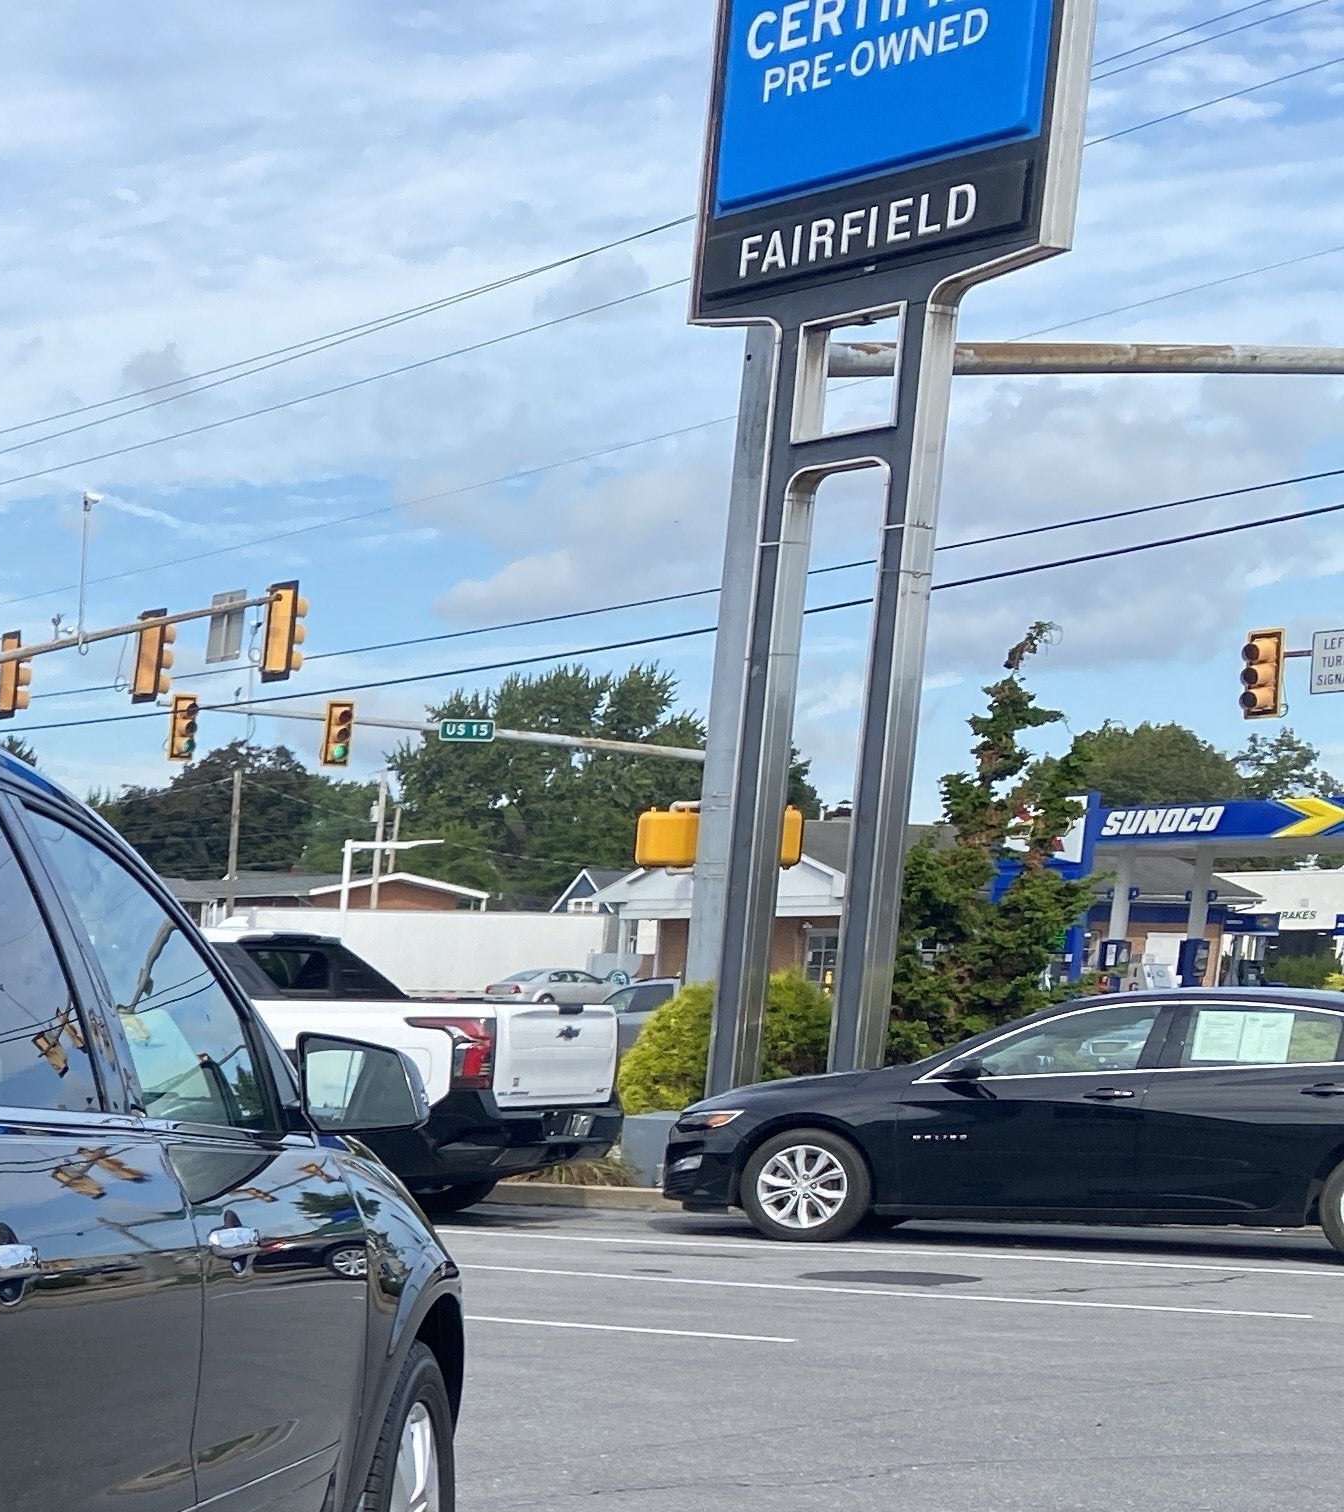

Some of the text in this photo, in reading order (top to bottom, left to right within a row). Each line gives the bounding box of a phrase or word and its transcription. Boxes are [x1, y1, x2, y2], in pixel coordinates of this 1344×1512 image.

[762, 8, 990, 104] PRE-OWNED
[738, 182, 978, 280] FAIRFIELD
[1323, 637, 1344, 650] LEF
[1322, 655, 1344, 668] TUR
[1316, 673, 1344, 686] SIGN
[446, 723, 489, 737] US 15
[1100, 805, 1225, 836] SUNOCO
[1276, 910, 1317, 920] RAKES
